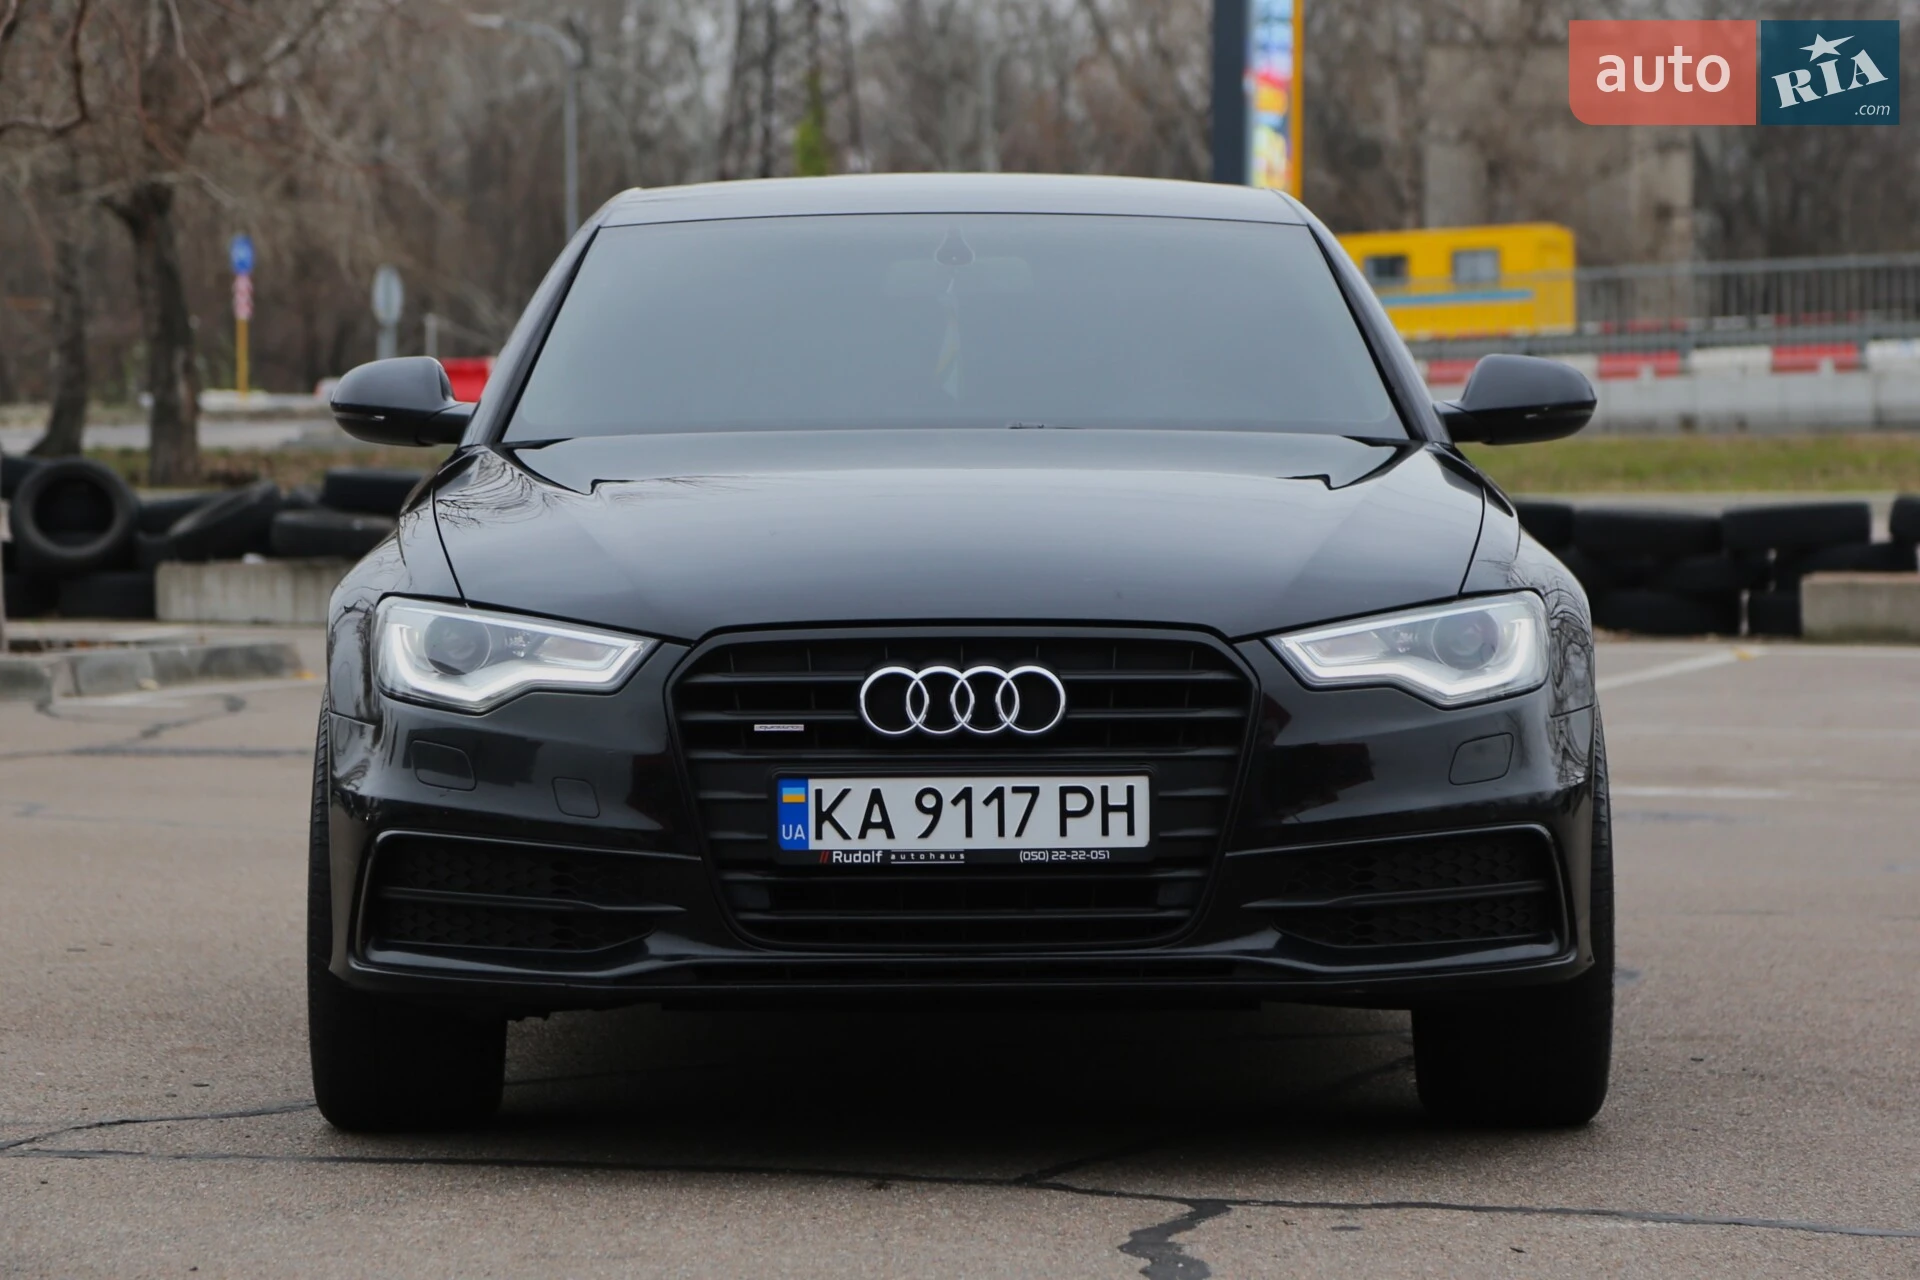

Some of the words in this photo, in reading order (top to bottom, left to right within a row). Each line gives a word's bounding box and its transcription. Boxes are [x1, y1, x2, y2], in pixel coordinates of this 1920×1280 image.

[814, 787, 896, 841] KA
[914, 785, 1040, 840] 9117
[1059, 784, 1136, 838] PH
[781, 823, 806, 841] UA
[832, 850, 883, 863] Rudolf
[890, 852, 965, 860] autohaus
[1019, 850, 1049, 863] (050)
[1051, 850, 1110, 861] 22-22-051
